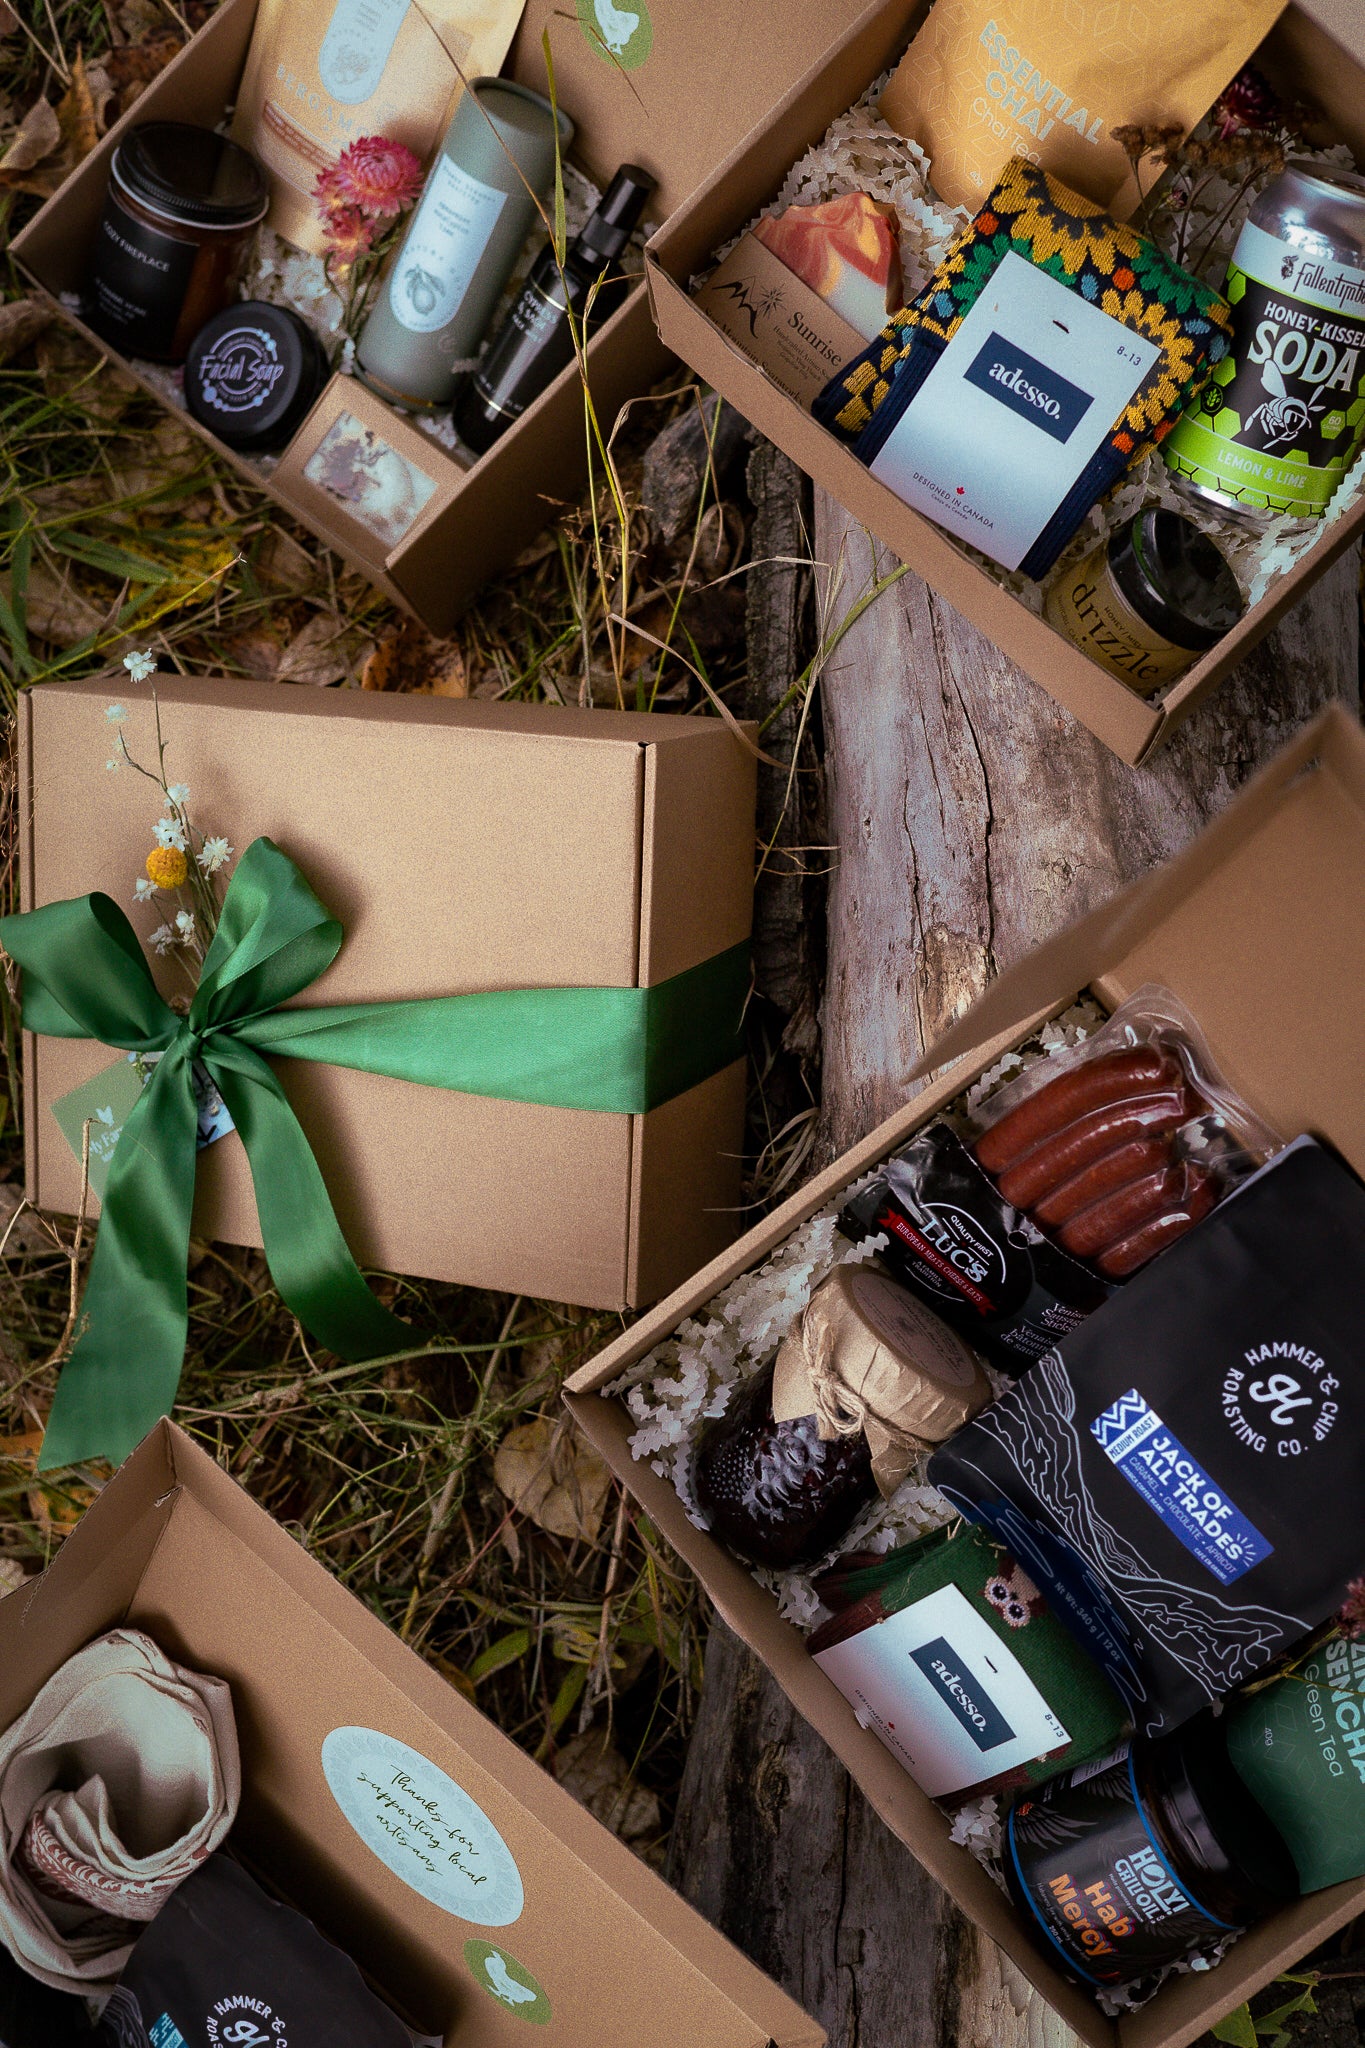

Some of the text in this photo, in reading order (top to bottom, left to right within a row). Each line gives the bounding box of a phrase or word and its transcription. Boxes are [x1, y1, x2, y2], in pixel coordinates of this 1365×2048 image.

[979, 19, 1104, 145] ESSENTIAL
[985, 70, 1055, 141] CHAI
[973, 97, 1042, 166] Chai Tea
[119, 239, 170, 273] FIREPLACE
[198, 355, 284, 390] Facial Soap
[787, 311, 842, 367] Sunrise
[1117, 345, 1142, 367] 8-13
[1247, 320, 1360, 392] SODA
[988, 362, 1060, 420] adesso.
[1328, 415, 1342, 426] 60
[913, 472, 995, 529] DESIGNED IN CANADA
[1217, 450, 1307, 489] LEMON & LIME
[1072, 583, 1159, 680] drizzle
[896, 1222, 926, 1253] EUROPEAN
[924, 1249, 944, 1268] MEATS
[942, 1266, 965, 1286] CHEESE
[966, 1284, 983, 1302] EATS
[950, 1215, 994, 1258] QUALITY FIRST
[912, 1261, 942, 1288] TRADITION
[1222, 1367, 1309, 1457] ROASTING CO.
[1244, 1342, 1340, 1441] HAMMER & CHIP
[1109, 1417, 1156, 1459] MEDIUM ROAST
[1137, 1449, 1243, 1561] ALL TRADES
[1152, 1436, 1233, 1521] JACK OF
[1129, 1456, 1237, 1574] CARAMEL CHOCOLATE APRICOT
[1076, 1607, 1093, 1625] 340
[1102, 1638, 1114, 1651] 12
[1110, 1650, 1121, 1662] oz
[855, 1689, 884, 1725] DESIGNED
[883, 1725, 892, 1734] IN
[891, 1735, 916, 1765] CANADA
[930, 1659, 987, 1732] adesso.
[1044, 1713, 1065, 1738] 8-13
[1304, 1663, 1344, 1777] Green Tea
[357, 1771, 488, 1886] supporting local
[390, 1764, 480, 1855] Thanks for
[376, 1814, 444, 1877] artisans
[1049, 1873, 1114, 1956] Mercy
[1084, 1880, 1132, 1937] Hab
[1128, 1846, 1190, 1916] HOLY!
[213, 1995, 286, 2034] HAMMER &
